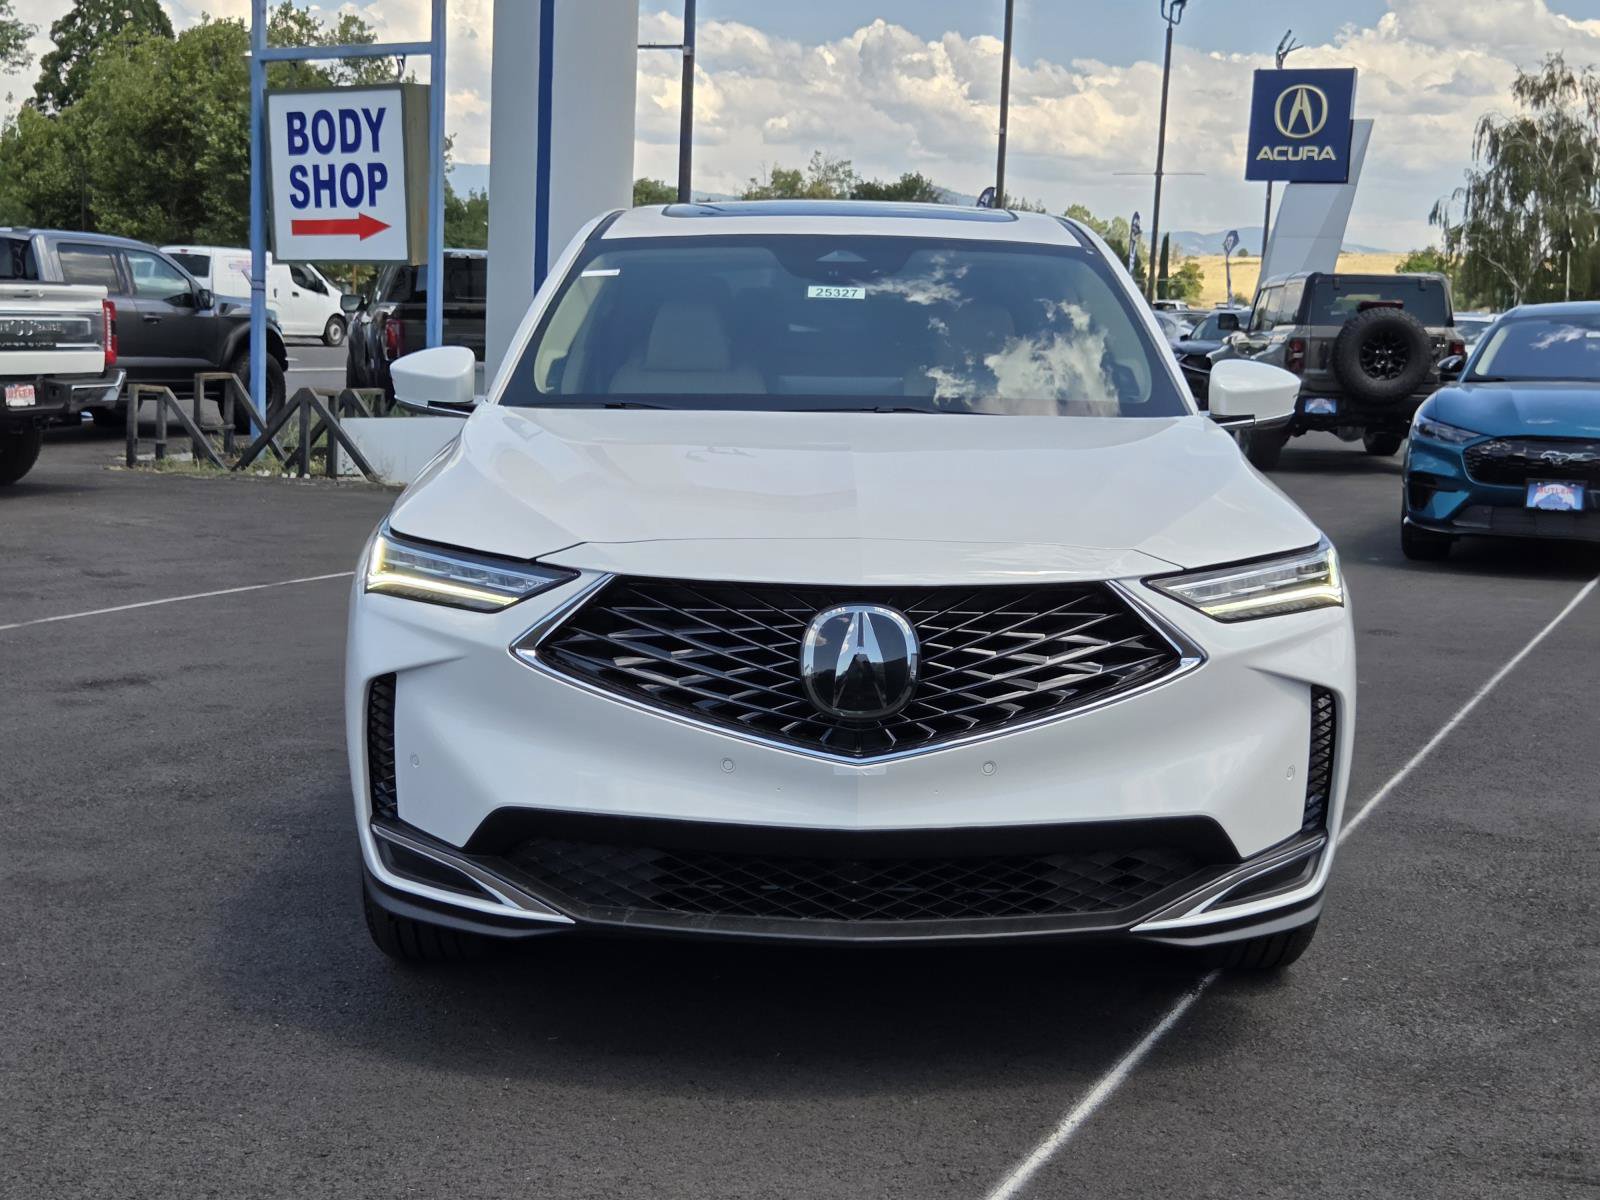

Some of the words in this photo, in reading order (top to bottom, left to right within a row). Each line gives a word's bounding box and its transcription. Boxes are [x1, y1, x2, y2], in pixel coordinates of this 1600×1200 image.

[286, 107, 387, 156] BODY
[1256, 145, 1336, 161] ACURA
[289, 162, 388, 209] SHOP
[815, 287, 858, 297] 25327
